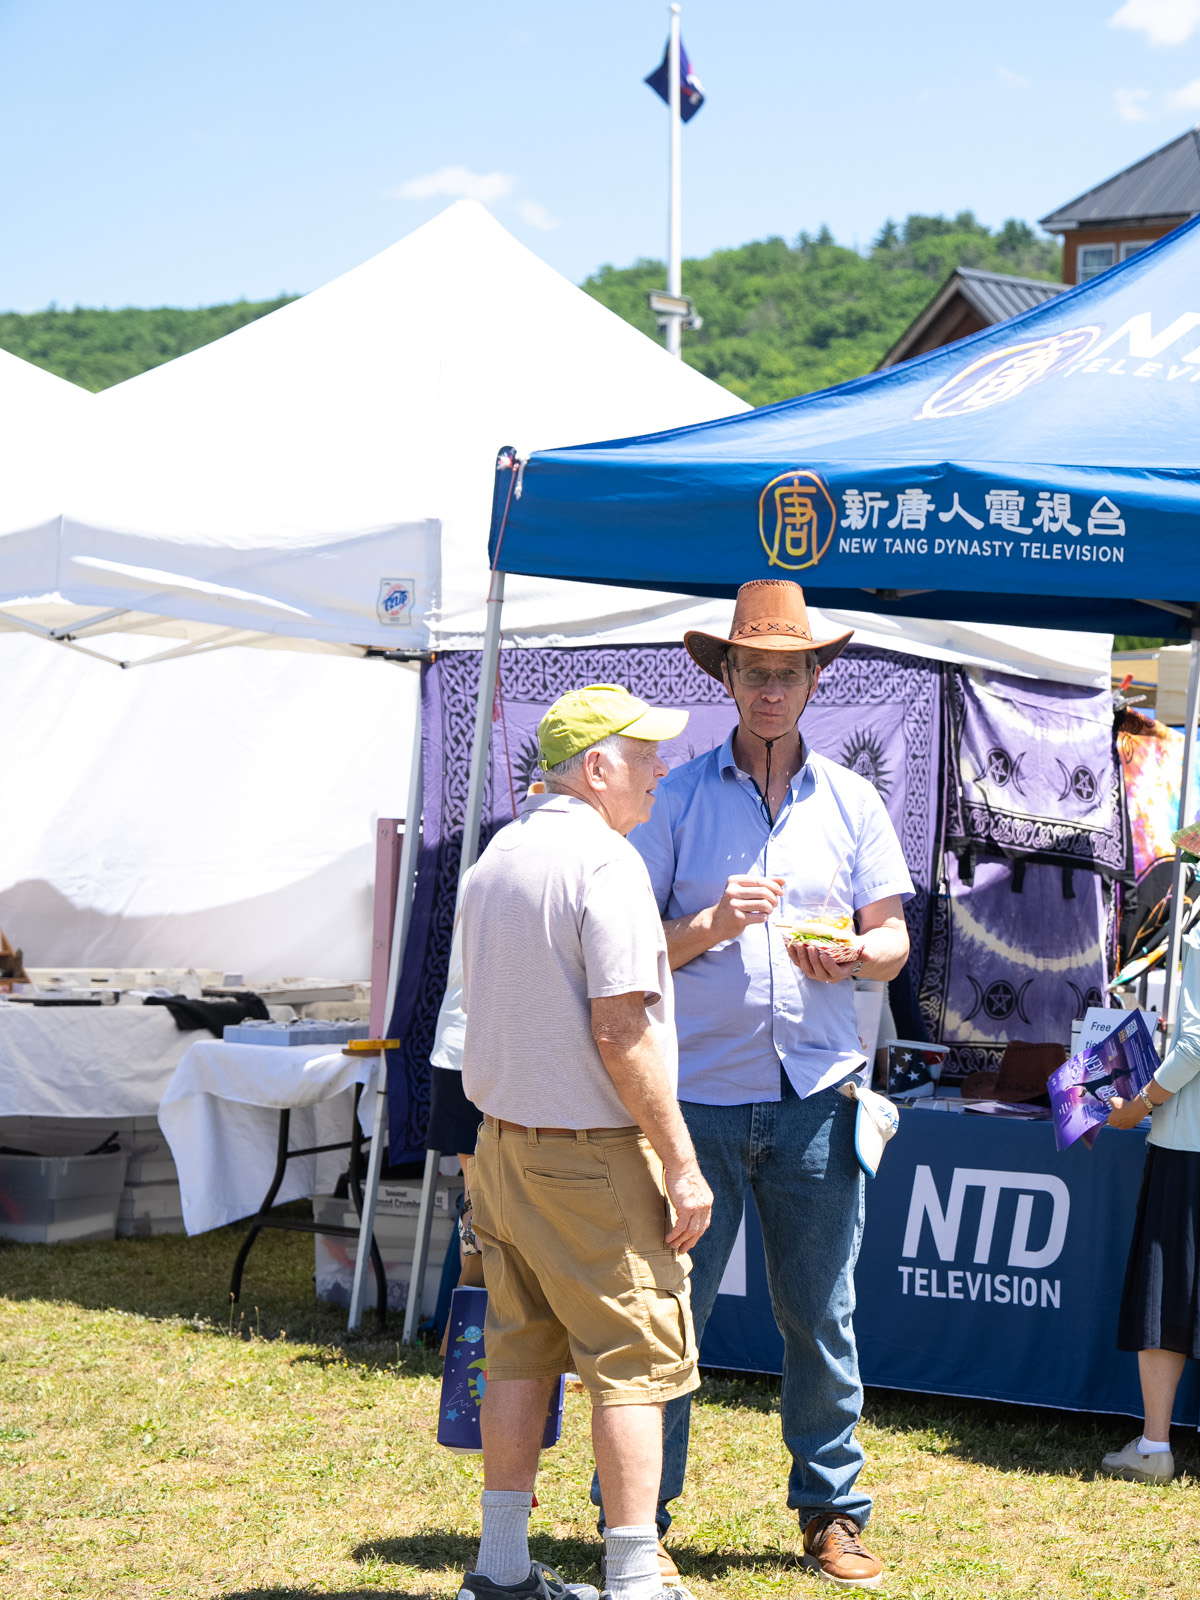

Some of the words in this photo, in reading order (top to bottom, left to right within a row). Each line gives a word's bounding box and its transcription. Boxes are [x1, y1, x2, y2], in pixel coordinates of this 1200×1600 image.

[839, 488, 1126, 537] 新唐人電視台
[839, 537, 878, 554] NEW
[884, 538, 929, 554] TANG
[934, 539, 1015, 558] DYNASTY
[1020, 542, 1125, 563] TELEVISION
[1091, 1022, 1111, 1032] Free
[902, 1164, 1071, 1269] NTD
[898, 1265, 1061, 1309] TELEVISION
